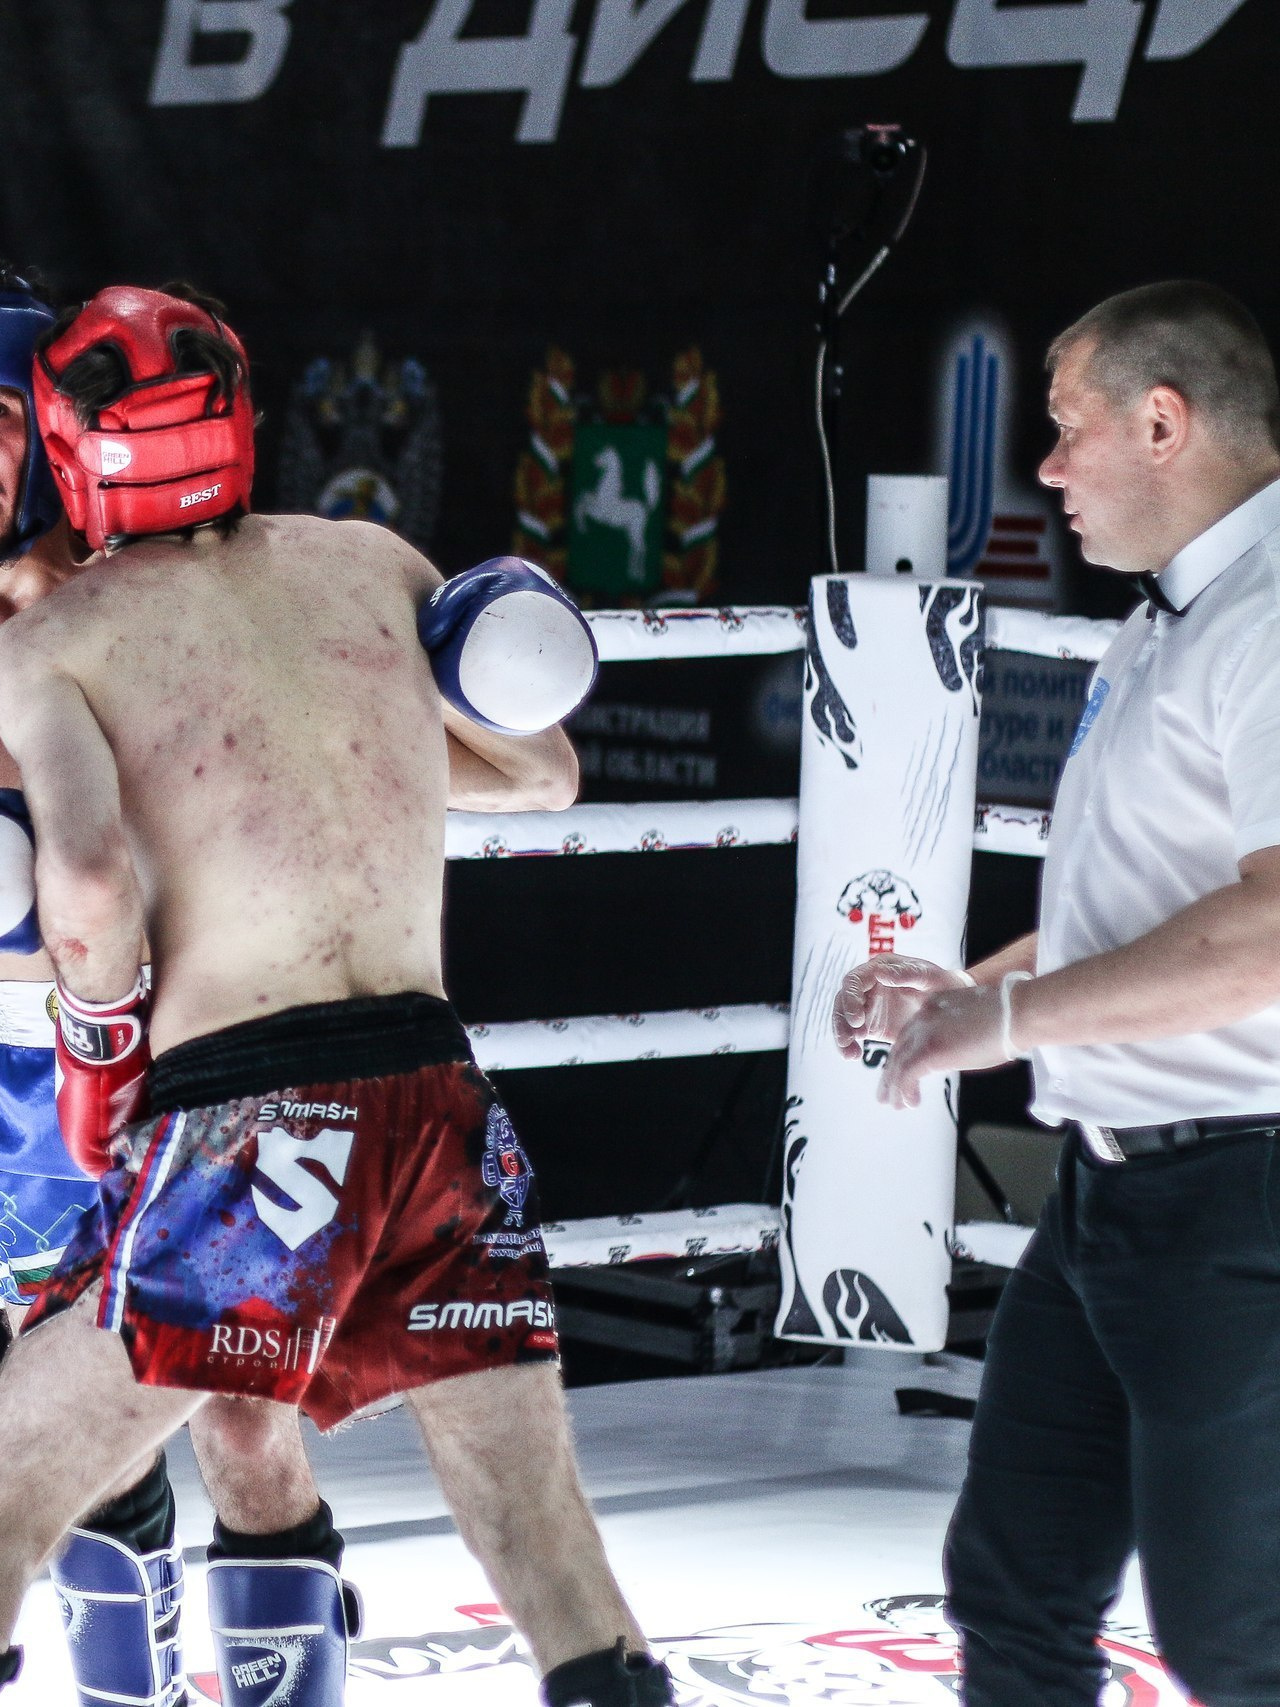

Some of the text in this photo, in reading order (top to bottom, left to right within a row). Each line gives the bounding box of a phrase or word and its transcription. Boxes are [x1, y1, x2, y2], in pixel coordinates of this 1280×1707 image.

[180, 484, 221, 508] BEST
[209, 1324, 281, 1358] RDS
[231, 1653, 281, 1676] GREEN
[235, 1668, 279, 1689] HILL
